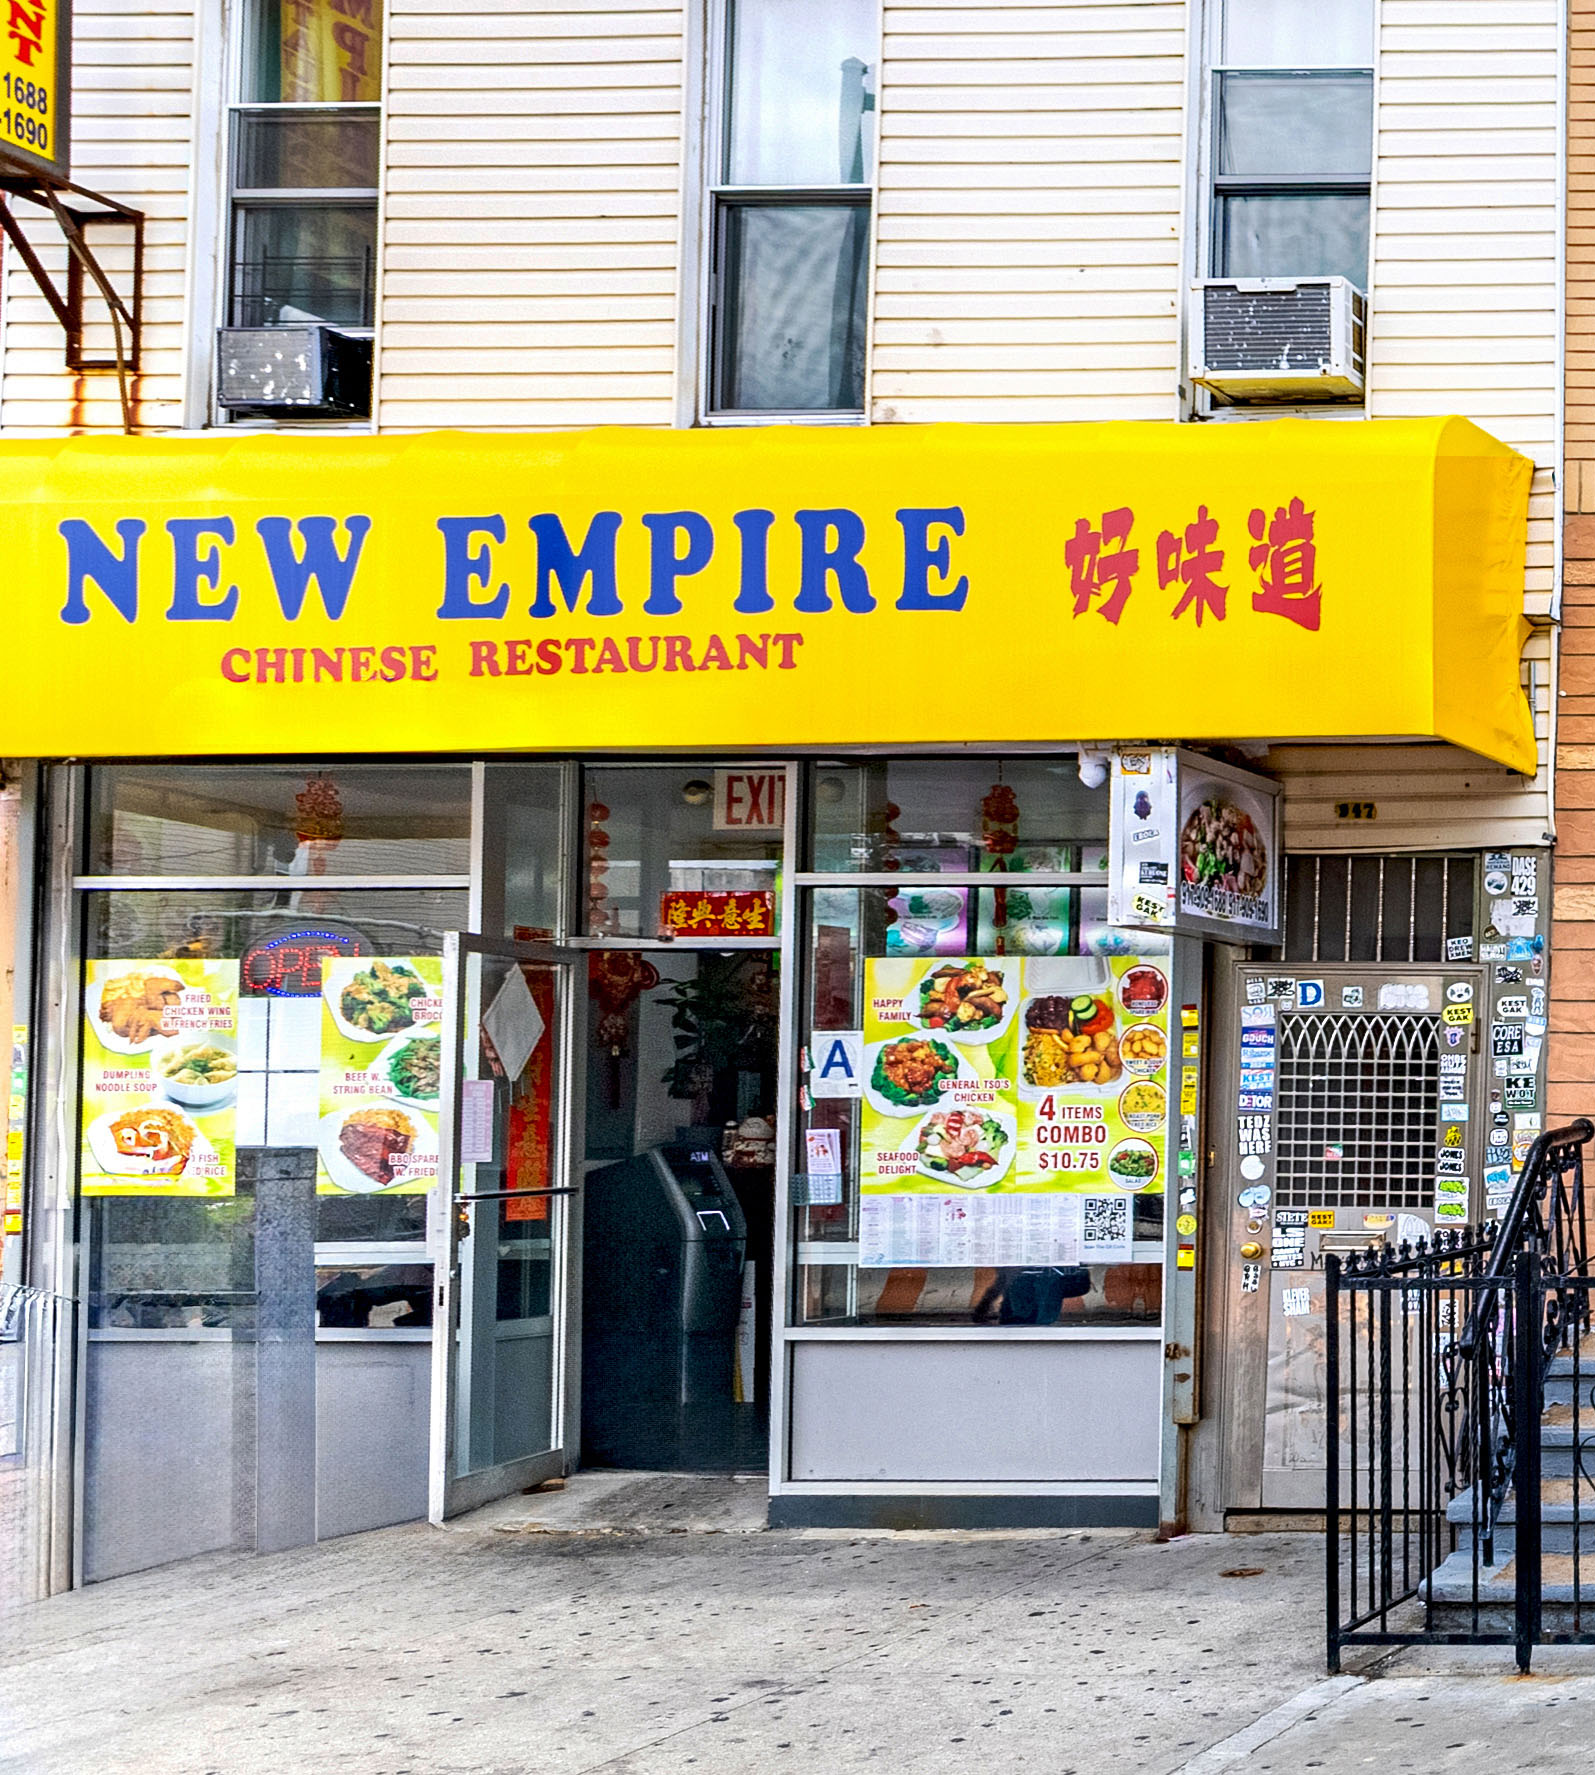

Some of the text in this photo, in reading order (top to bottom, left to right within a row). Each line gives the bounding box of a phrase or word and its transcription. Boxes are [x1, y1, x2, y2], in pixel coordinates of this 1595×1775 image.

[4, 72, 47, 115] 1688
[0, 108, 47, 150] 1690
[59, 506, 969, 625] NEW EMPIRE
[1065, 496, 1323, 632] 好味道
[221, 633, 804, 683] CHINESE RESTAURANT
[1511, 876, 1536, 896] 429
[243, 943, 360, 989] OPE
[185, 994, 211, 1003] FRIED
[1299, 982, 1322, 1006] D
[411, 998, 443, 1008] CHICKE
[873, 999, 903, 1008] HAPPY
[164, 1007, 231, 1016] CHICKEN WING
[1446, 1007, 1472, 1015] KEST
[879, 1012, 912, 1021] FAMILY
[209, 1019, 233, 1028] FRIES
[1493, 1025, 1522, 1040] CORE
[1496, 1041, 1519, 1053] ESA
[819, 1040, 854, 1078] A
[103, 1070, 150, 1079] DUMPLING
[345, 1072, 368, 1081] BEEF
[96, 1084, 158, 1092] NOODLE SOUP
[333, 1085, 393, 1094] STRING BEAN
[939, 1080, 1010, 1089] GENERAL TSO'S
[954, 1092, 995, 1102] CHICKEN
[1039, 1094, 1103, 1121] 4 ITEMS
[1037, 1125, 1106, 1143] COMBO
[1239, 1128, 1271, 1142] WAS
[1239, 1141, 1272, 1155] HERE
[199, 1154, 219, 1162] FISH
[389, 1155, 410, 1164] BBQ
[877, 1153, 919, 1162] SEAFOOD
[1039, 1152, 1100, 1170] $10.75
[204, 1167, 225, 1176] RICE
[878, 1165, 917, 1174] DELIGHT
